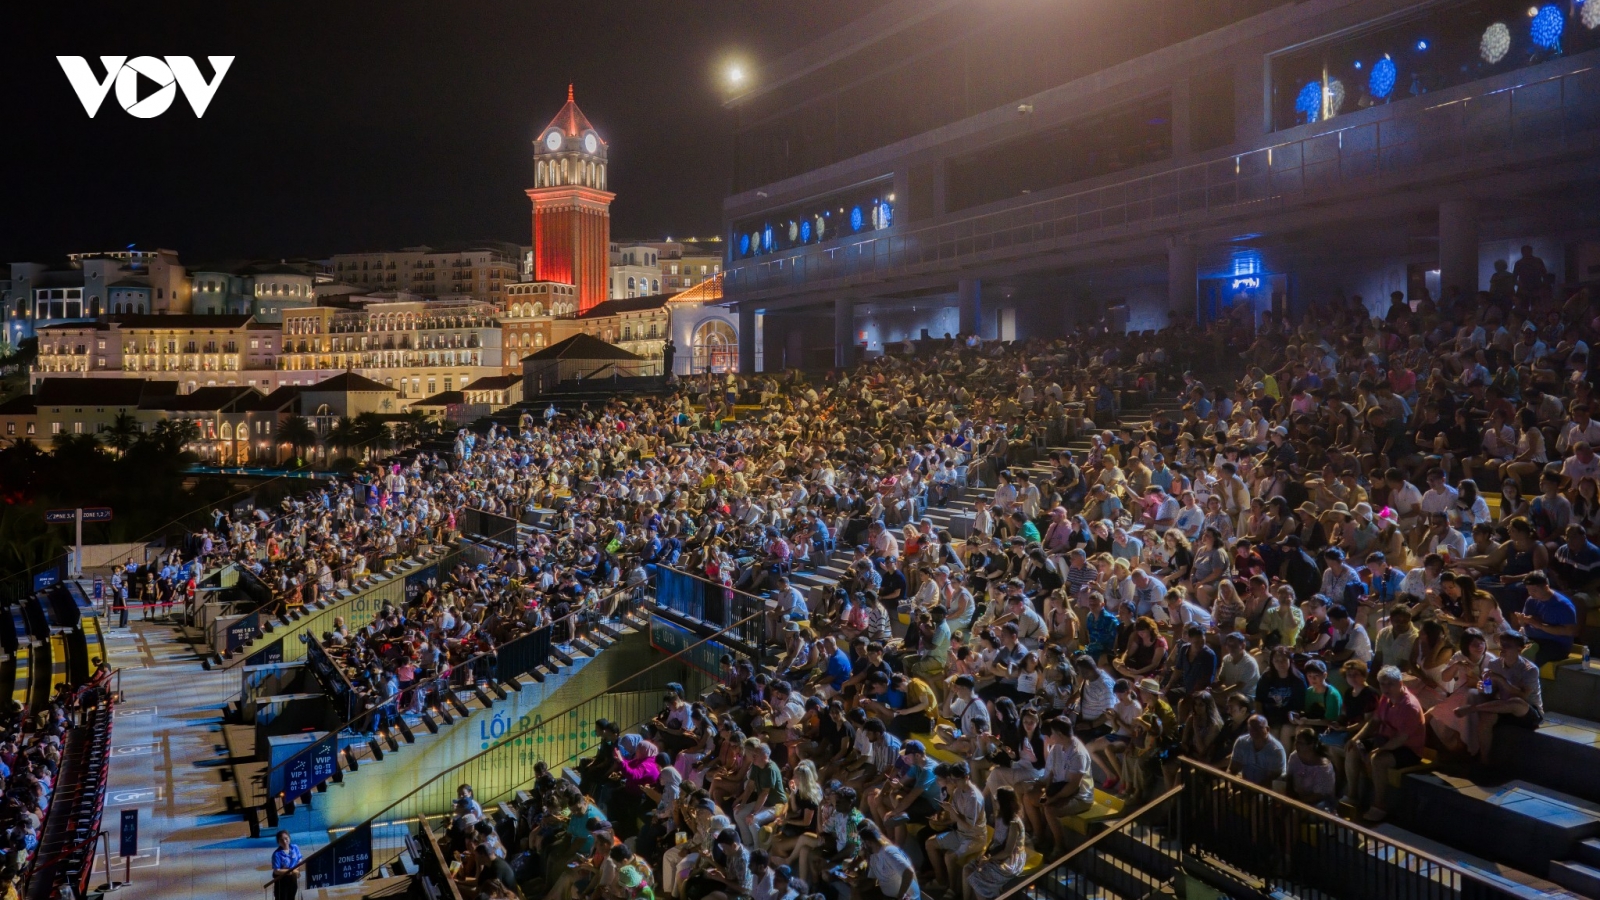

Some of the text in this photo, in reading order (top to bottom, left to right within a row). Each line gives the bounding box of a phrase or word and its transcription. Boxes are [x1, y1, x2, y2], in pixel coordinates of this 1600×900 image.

[481, 710, 511, 740] LỐI
[316, 756, 331, 764] VVIP
[338, 855, 355, 864] ZONE
[311, 873, 323, 882] VIP
